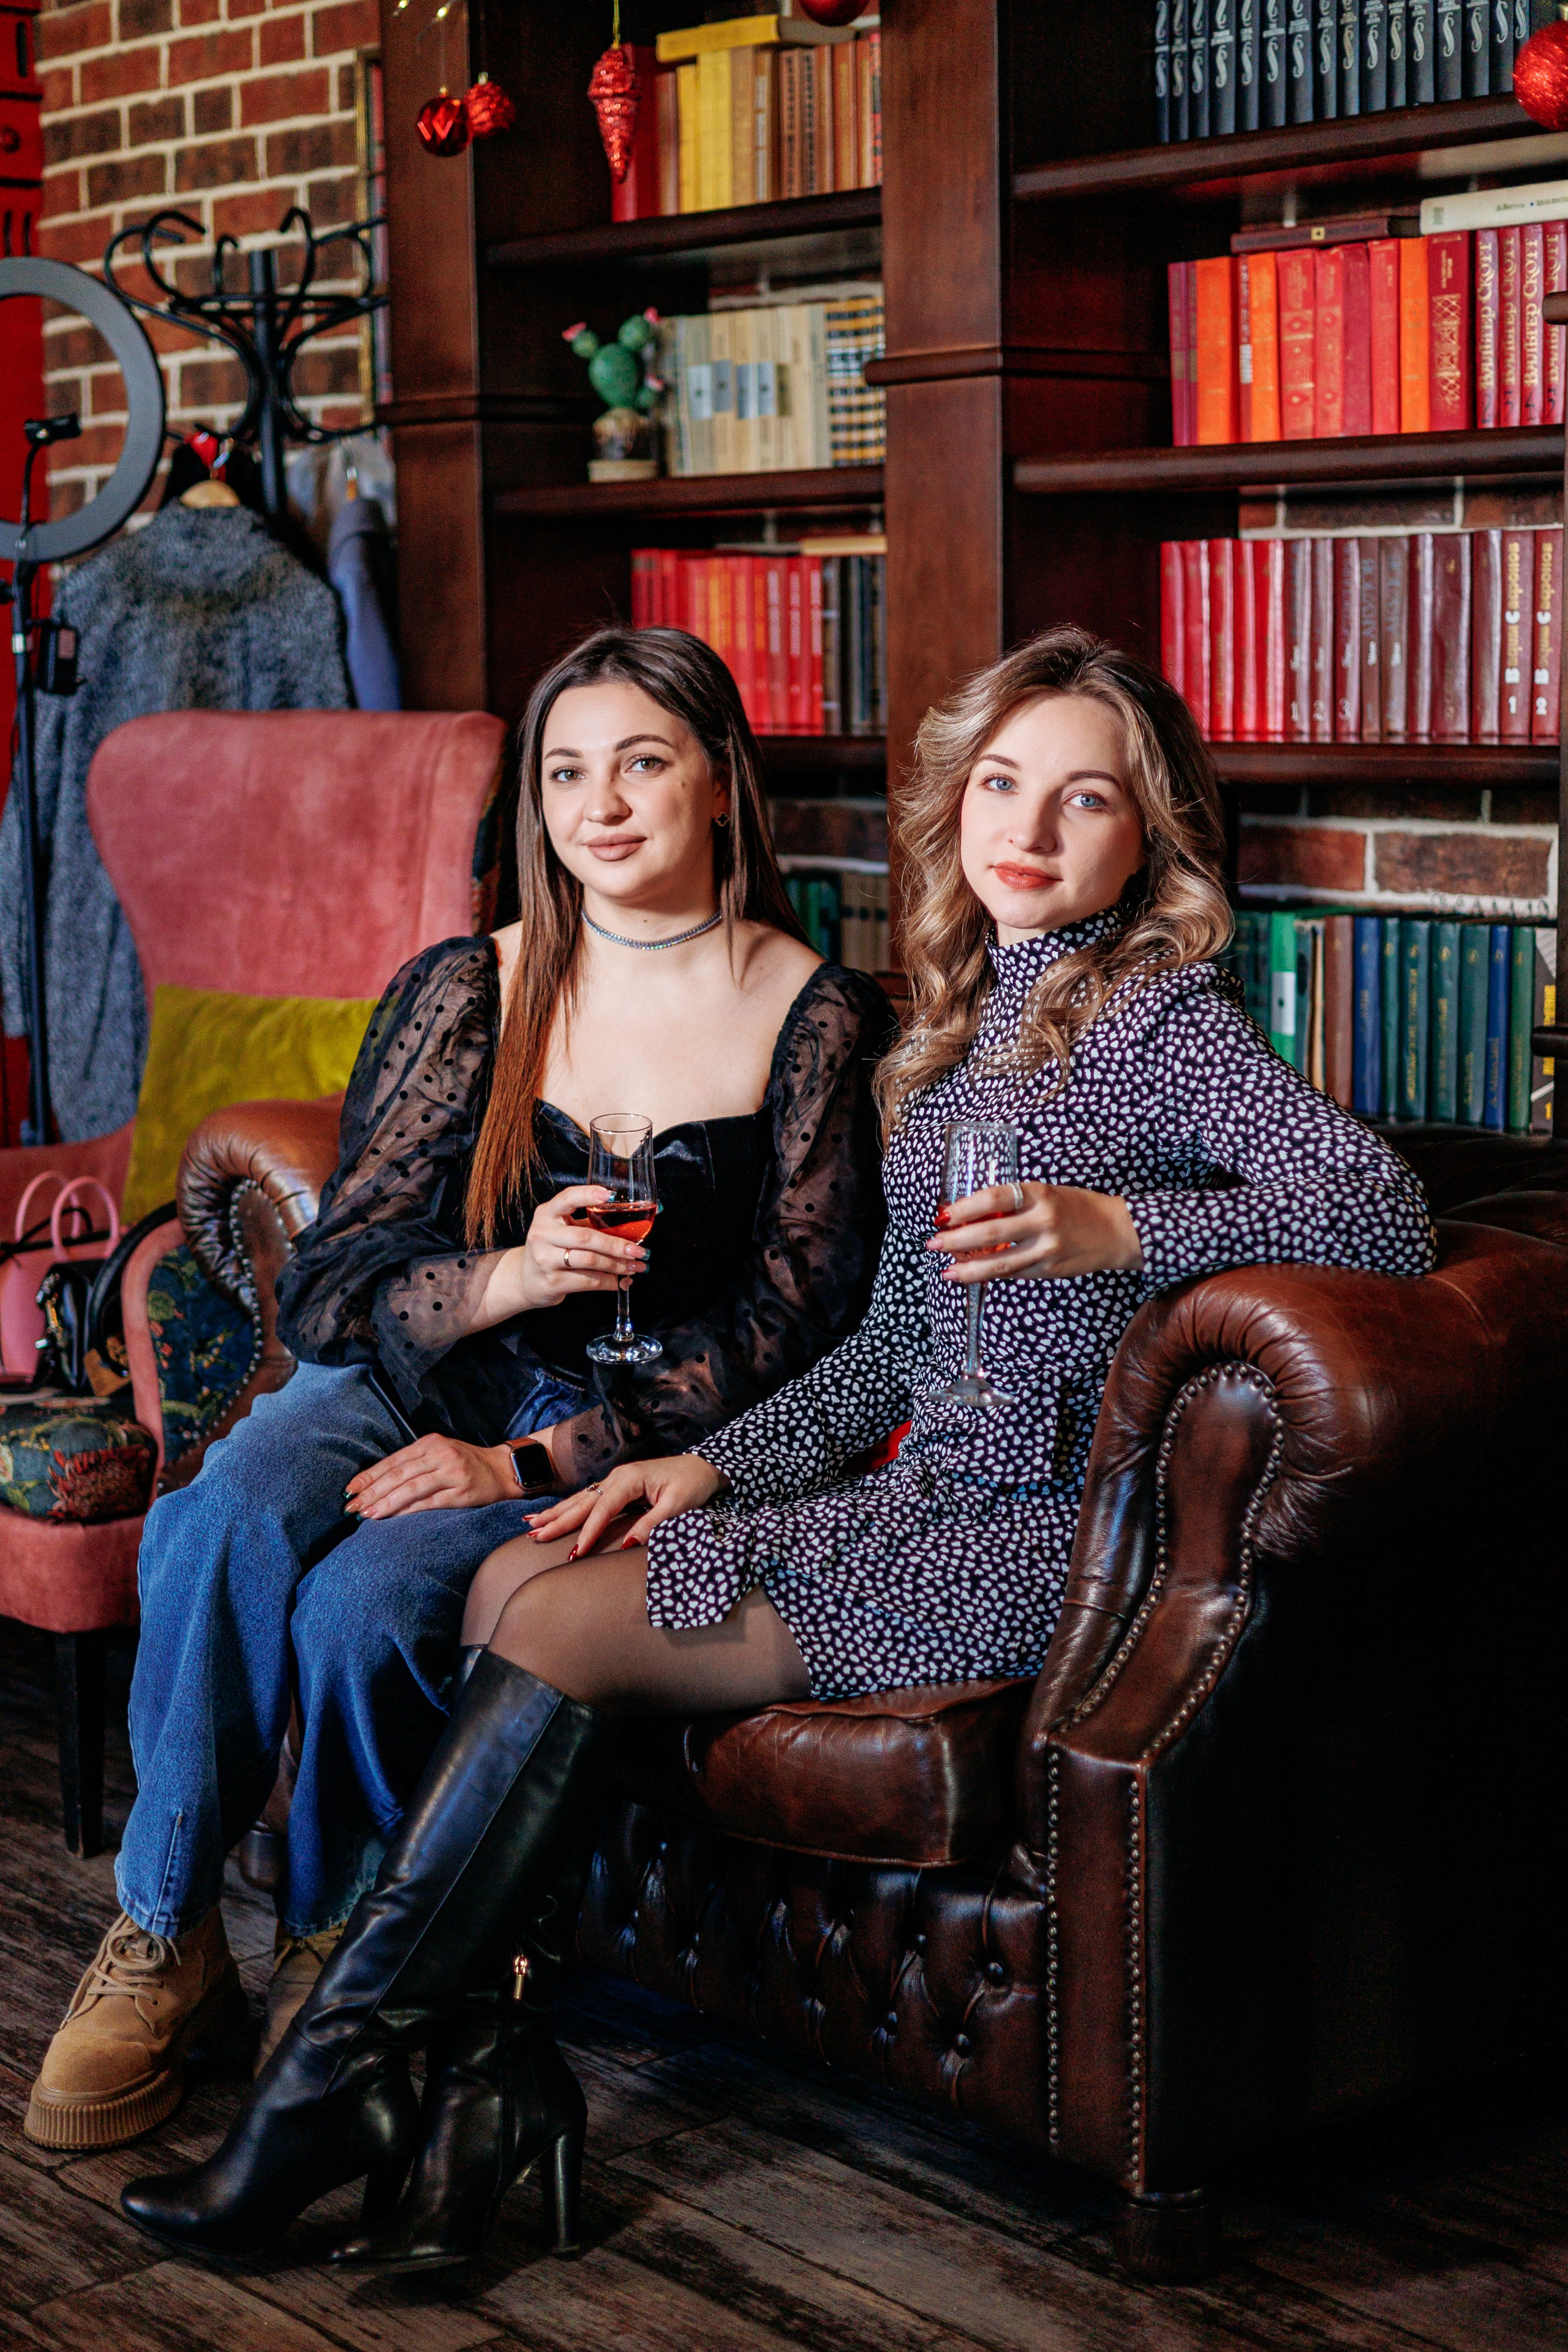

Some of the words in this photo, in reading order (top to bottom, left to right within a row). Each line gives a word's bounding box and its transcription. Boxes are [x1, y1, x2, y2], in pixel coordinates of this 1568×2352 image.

[1291, 702, 1299, 722] 1
[1313, 699, 1325, 722] 2
[1338, 698, 1352, 720] 3
[1508, 695, 1517, 715] 1
[1536, 696, 1548, 716] 2
